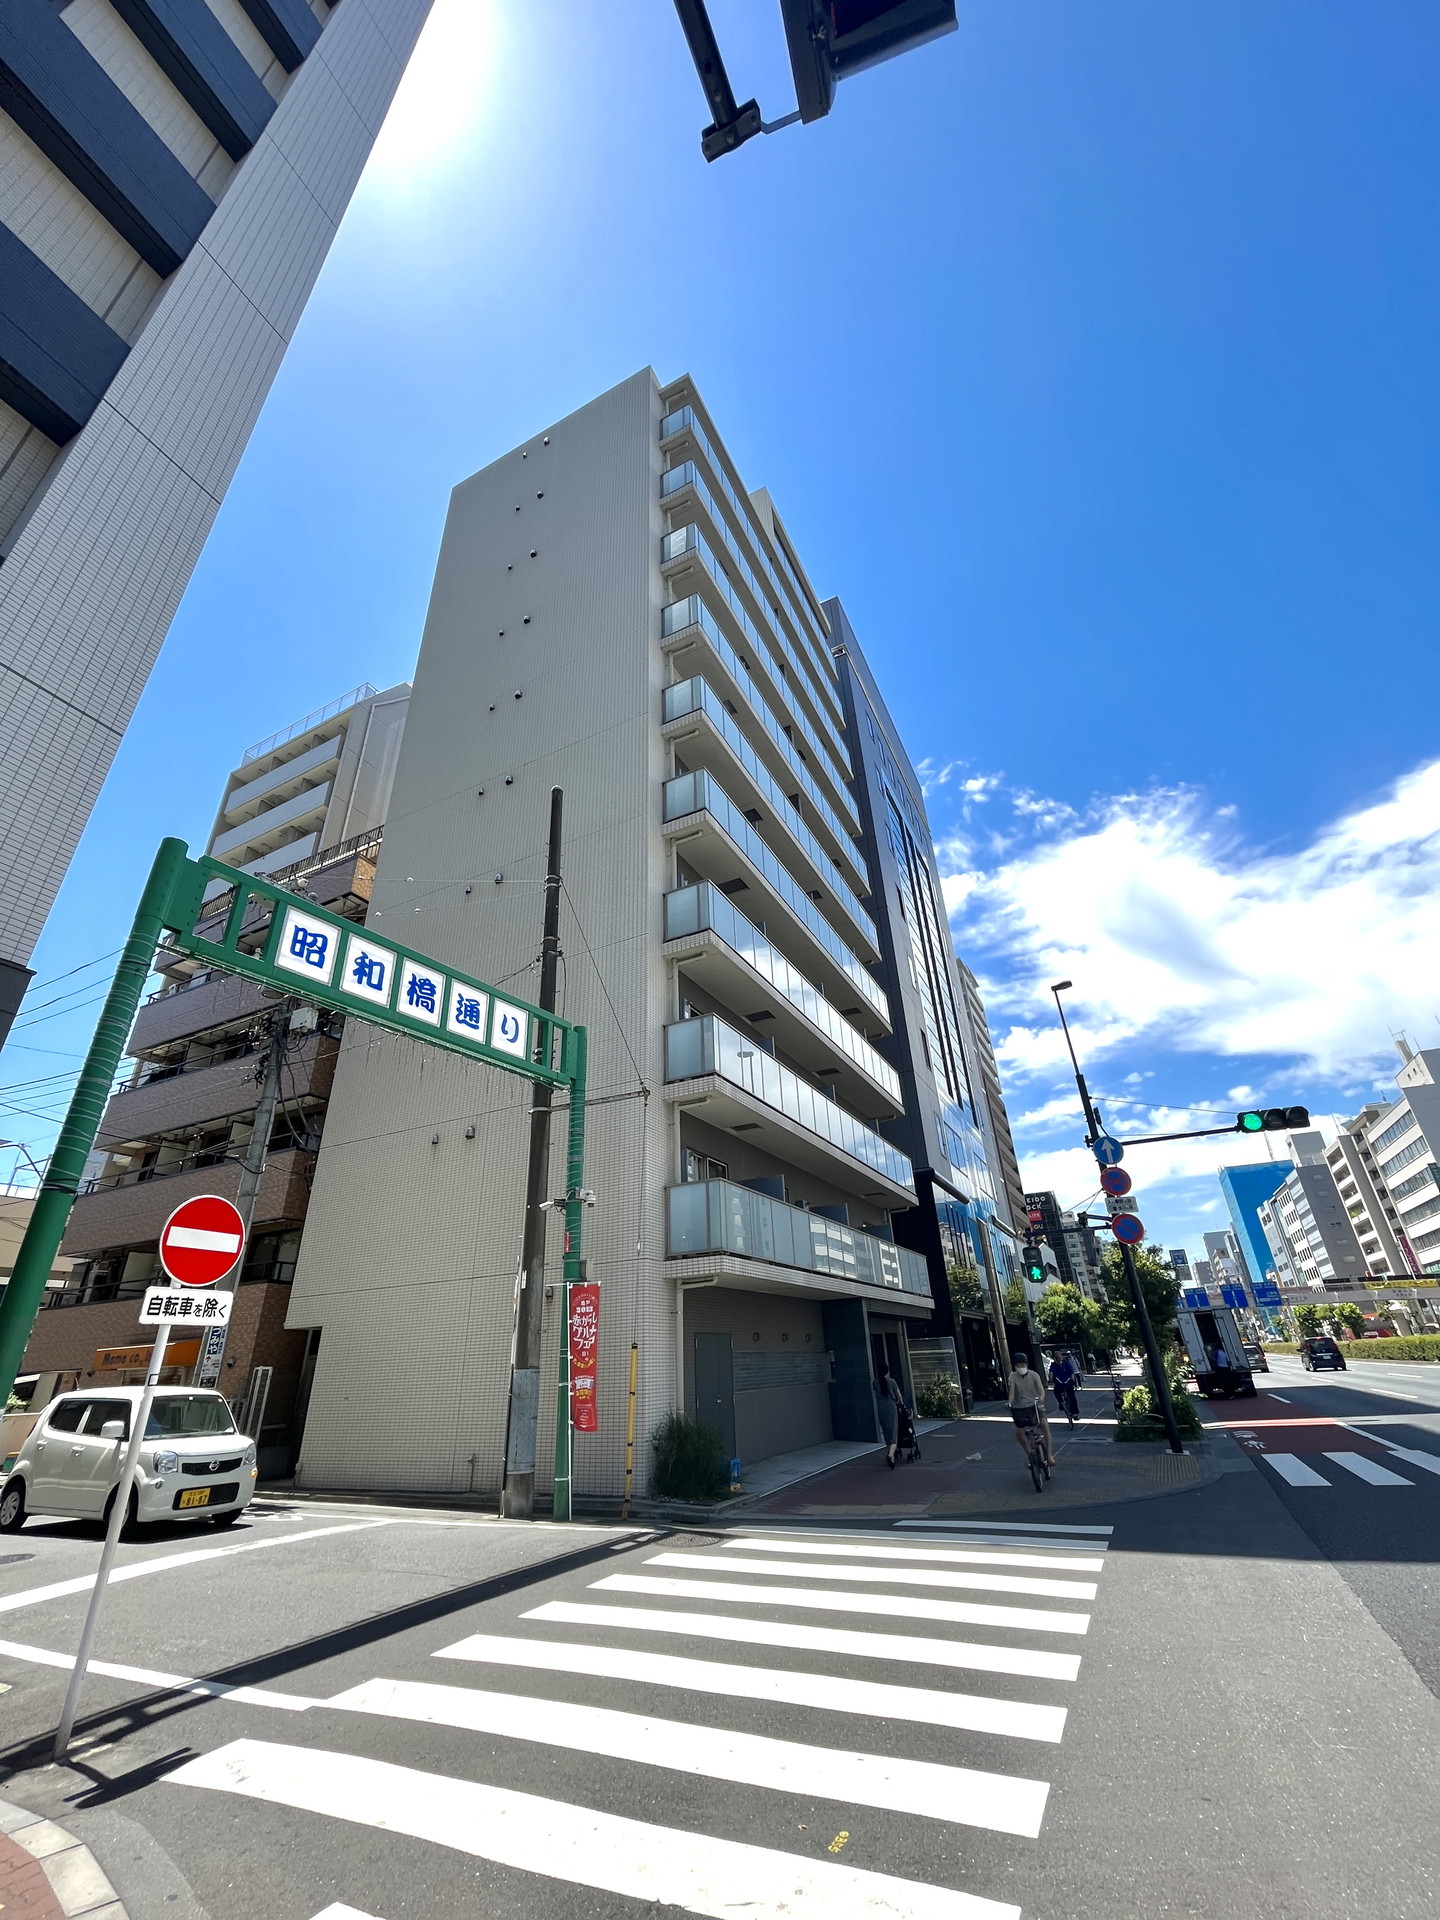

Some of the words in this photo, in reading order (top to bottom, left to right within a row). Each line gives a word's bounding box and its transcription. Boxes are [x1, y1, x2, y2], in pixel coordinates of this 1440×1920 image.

[290, 925, 519, 1043] 昭和橋通り
[147, 1295, 227, 1318] 自転車を除く
[573, 1324, 597, 1339] グルメ
[573, 1335, 596, 1350] フェア
[186, 1494, 208, 1506] 81-87
